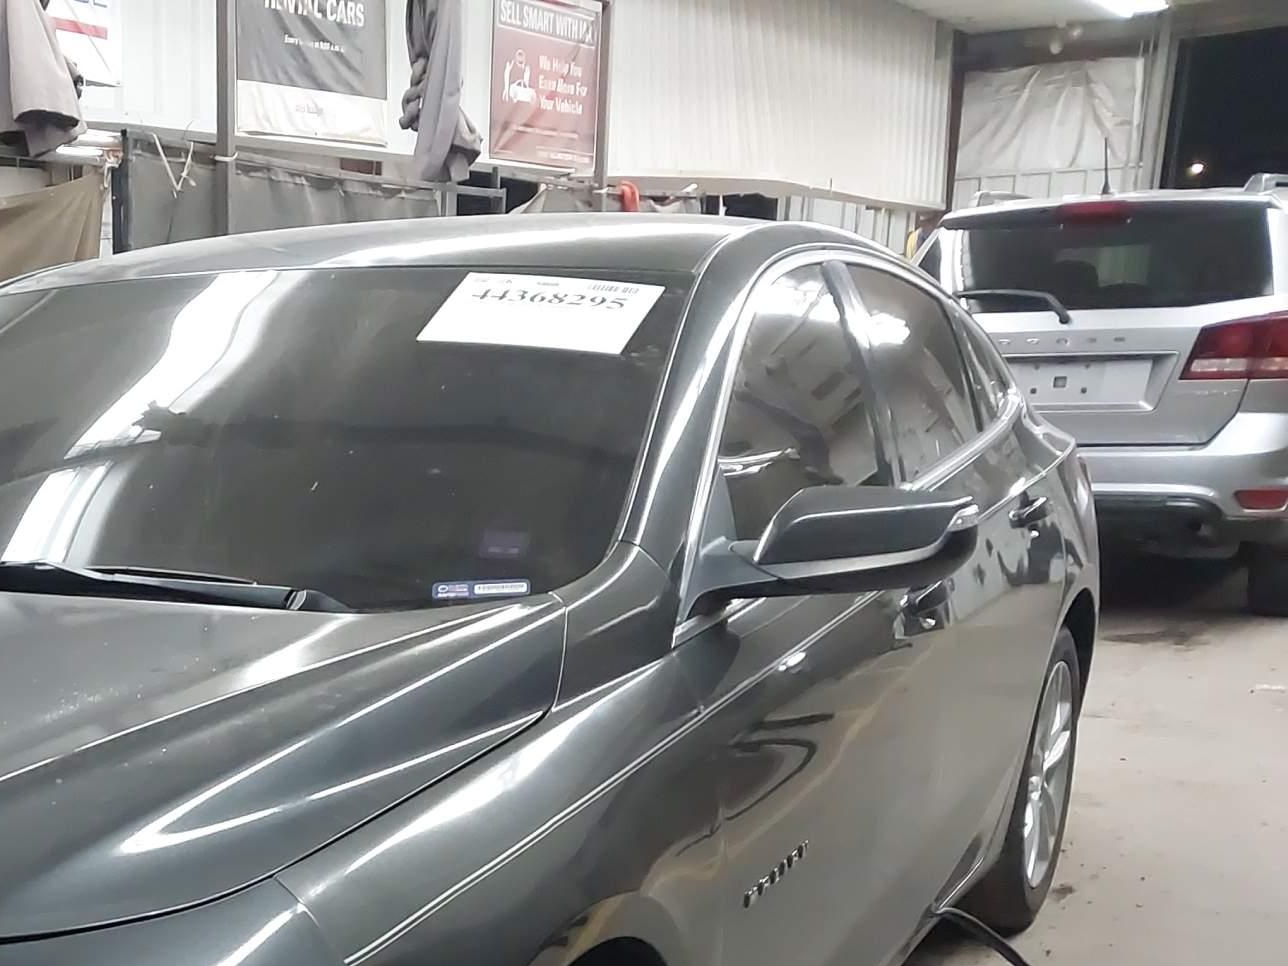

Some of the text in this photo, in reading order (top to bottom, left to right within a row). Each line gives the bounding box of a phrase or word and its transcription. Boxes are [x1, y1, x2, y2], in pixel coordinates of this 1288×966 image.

[326, 0, 364, 27] CARS
[500, 0, 521, 25] SELL
[522, 5, 554, 33] SMART
[555, 13, 578, 40] WITH
[555, 96, 583, 115] Vehicle
[471, 288, 628, 310] 44368295
